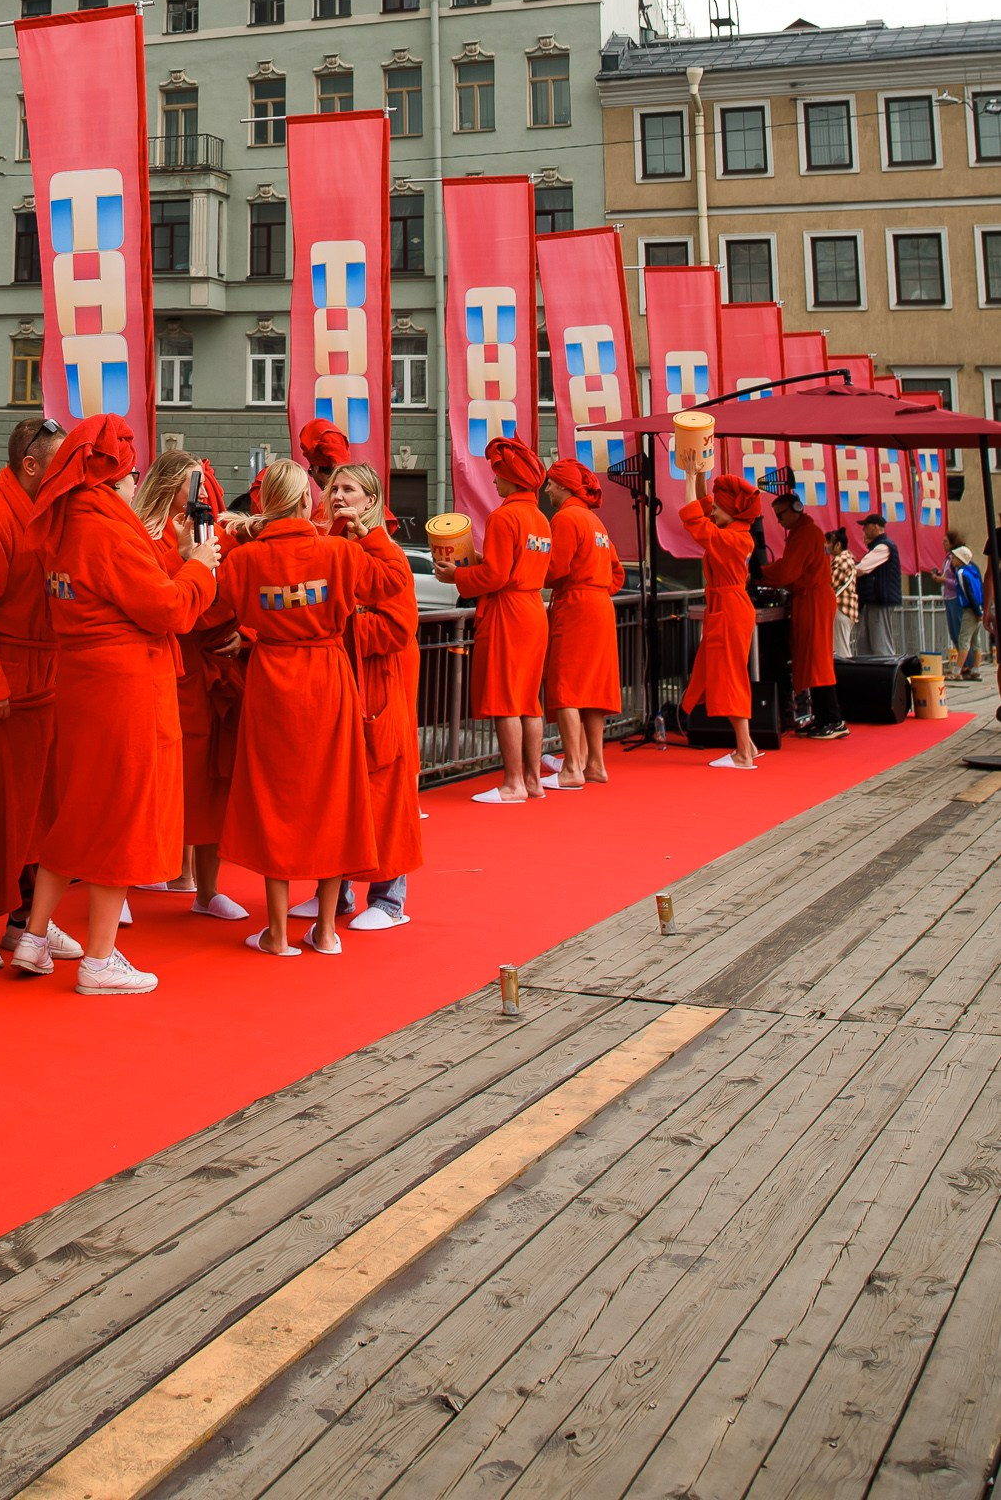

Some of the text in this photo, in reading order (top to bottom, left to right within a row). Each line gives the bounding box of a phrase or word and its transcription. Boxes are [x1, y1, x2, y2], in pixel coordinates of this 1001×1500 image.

[50, 168, 130, 418] ТНТ
[310, 240, 370, 444] ТНТ
[465, 286, 517, 457] ТНТ
[563, 324, 626, 473] ТНТ
[789, 441, 827, 506] НТ
[836, 444, 871, 513] НТ
[259, 578, 328, 611] ТНТ
[525, 533, 551, 554] ТНТ
